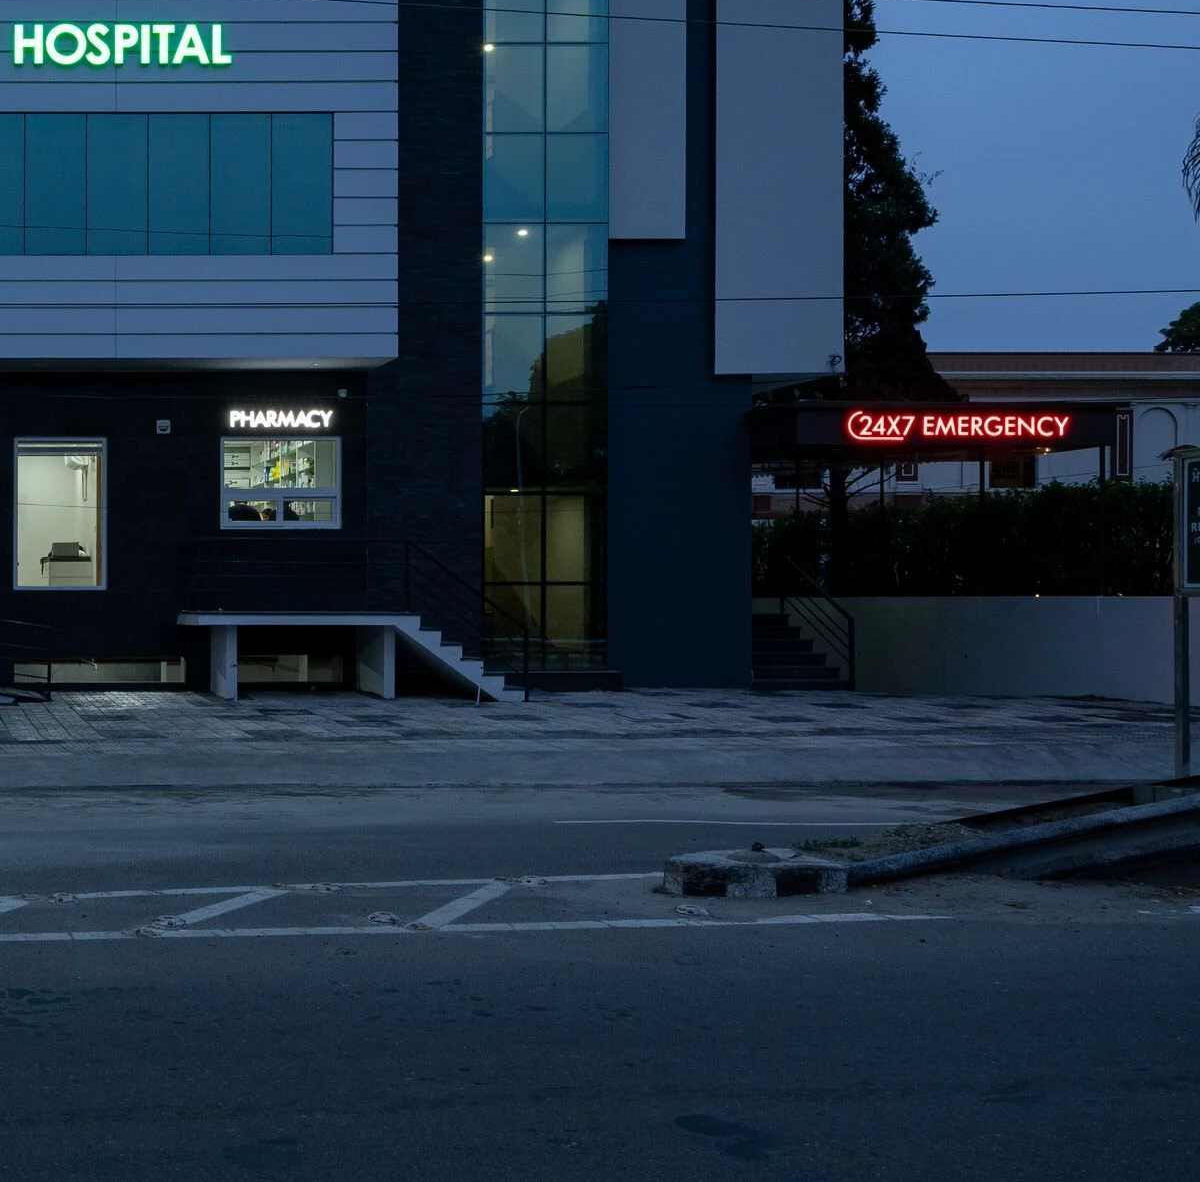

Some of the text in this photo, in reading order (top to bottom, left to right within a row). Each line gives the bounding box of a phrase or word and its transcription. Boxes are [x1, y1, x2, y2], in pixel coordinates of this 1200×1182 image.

[13, 23, 233, 65] HOSPITAL
[229, 409, 333, 428] PHARMACY
[859, 416, 1069, 437] 24X7 EMERGENCY
